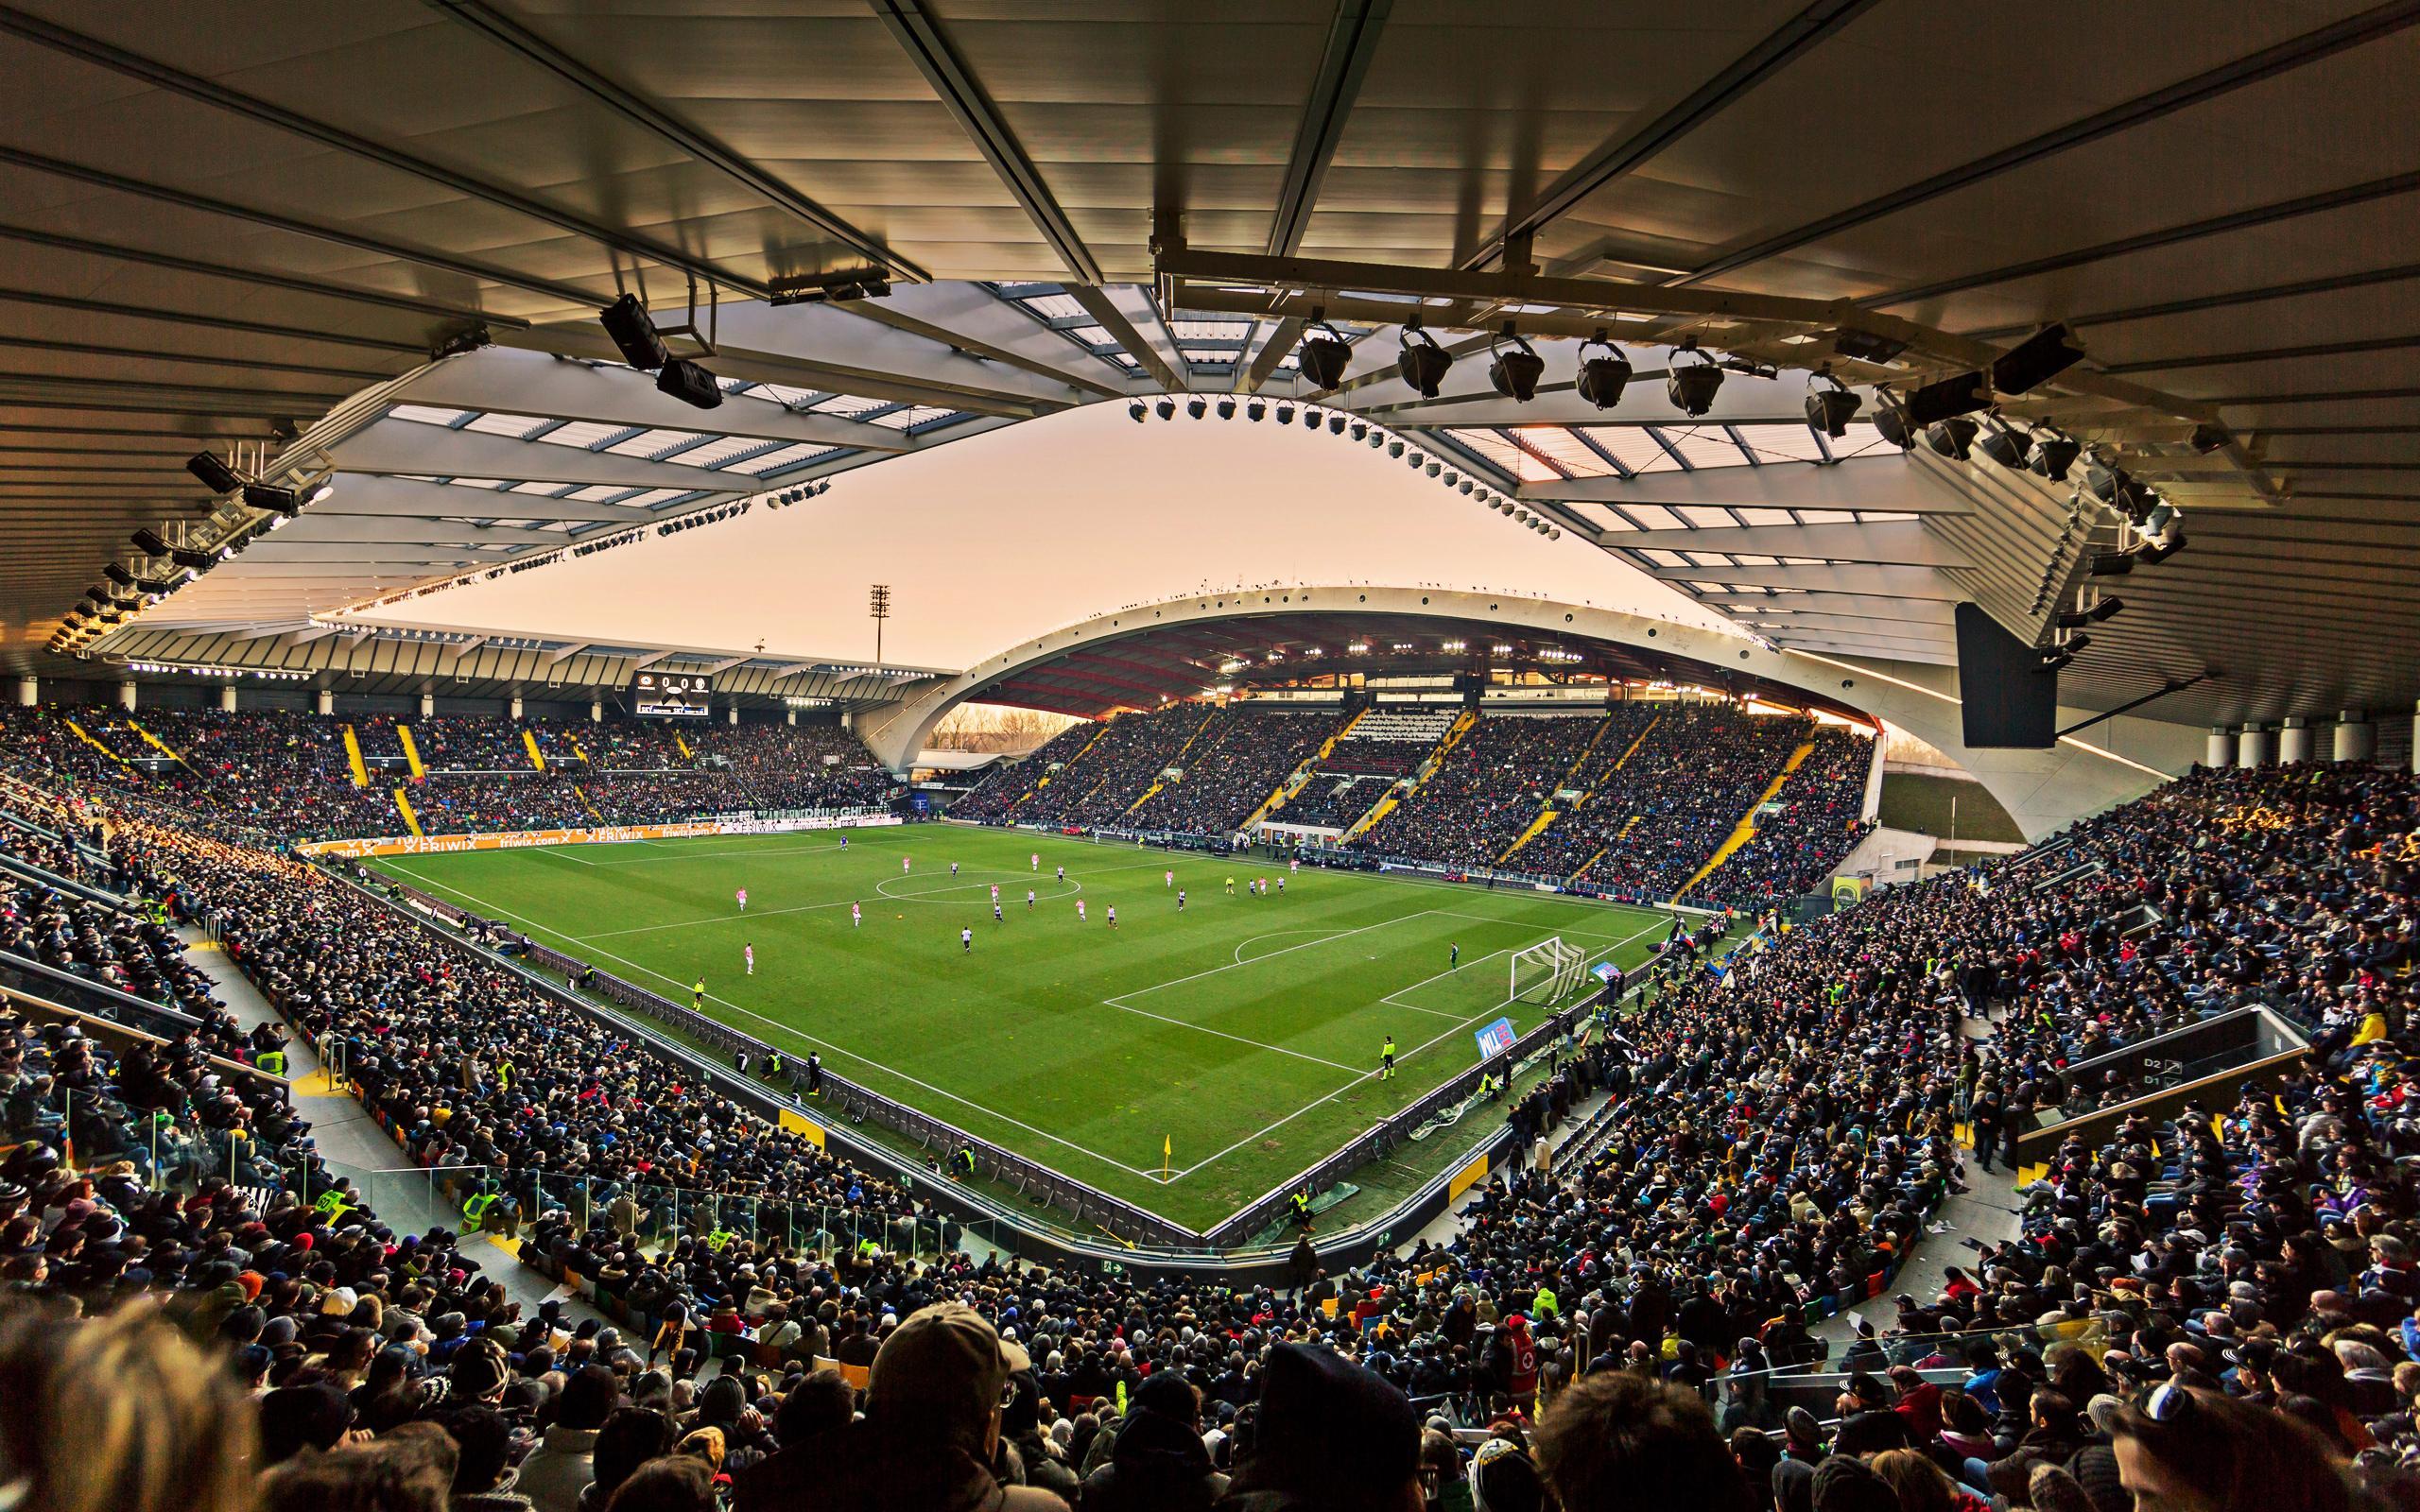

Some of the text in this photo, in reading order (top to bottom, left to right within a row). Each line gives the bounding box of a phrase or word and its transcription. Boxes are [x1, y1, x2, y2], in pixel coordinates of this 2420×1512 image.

[662, 677, 689, 690] 0 0
[500, 836, 560, 849] friwix.com
[598, 831, 644, 842] FRIWIX
[420, 839, 477, 853] FRIWIX
[1478, 1029, 1504, 1059] TIM
[2144, 1058, 2161, 1069] D2
[2144, 1075, 2160, 1086] D1
